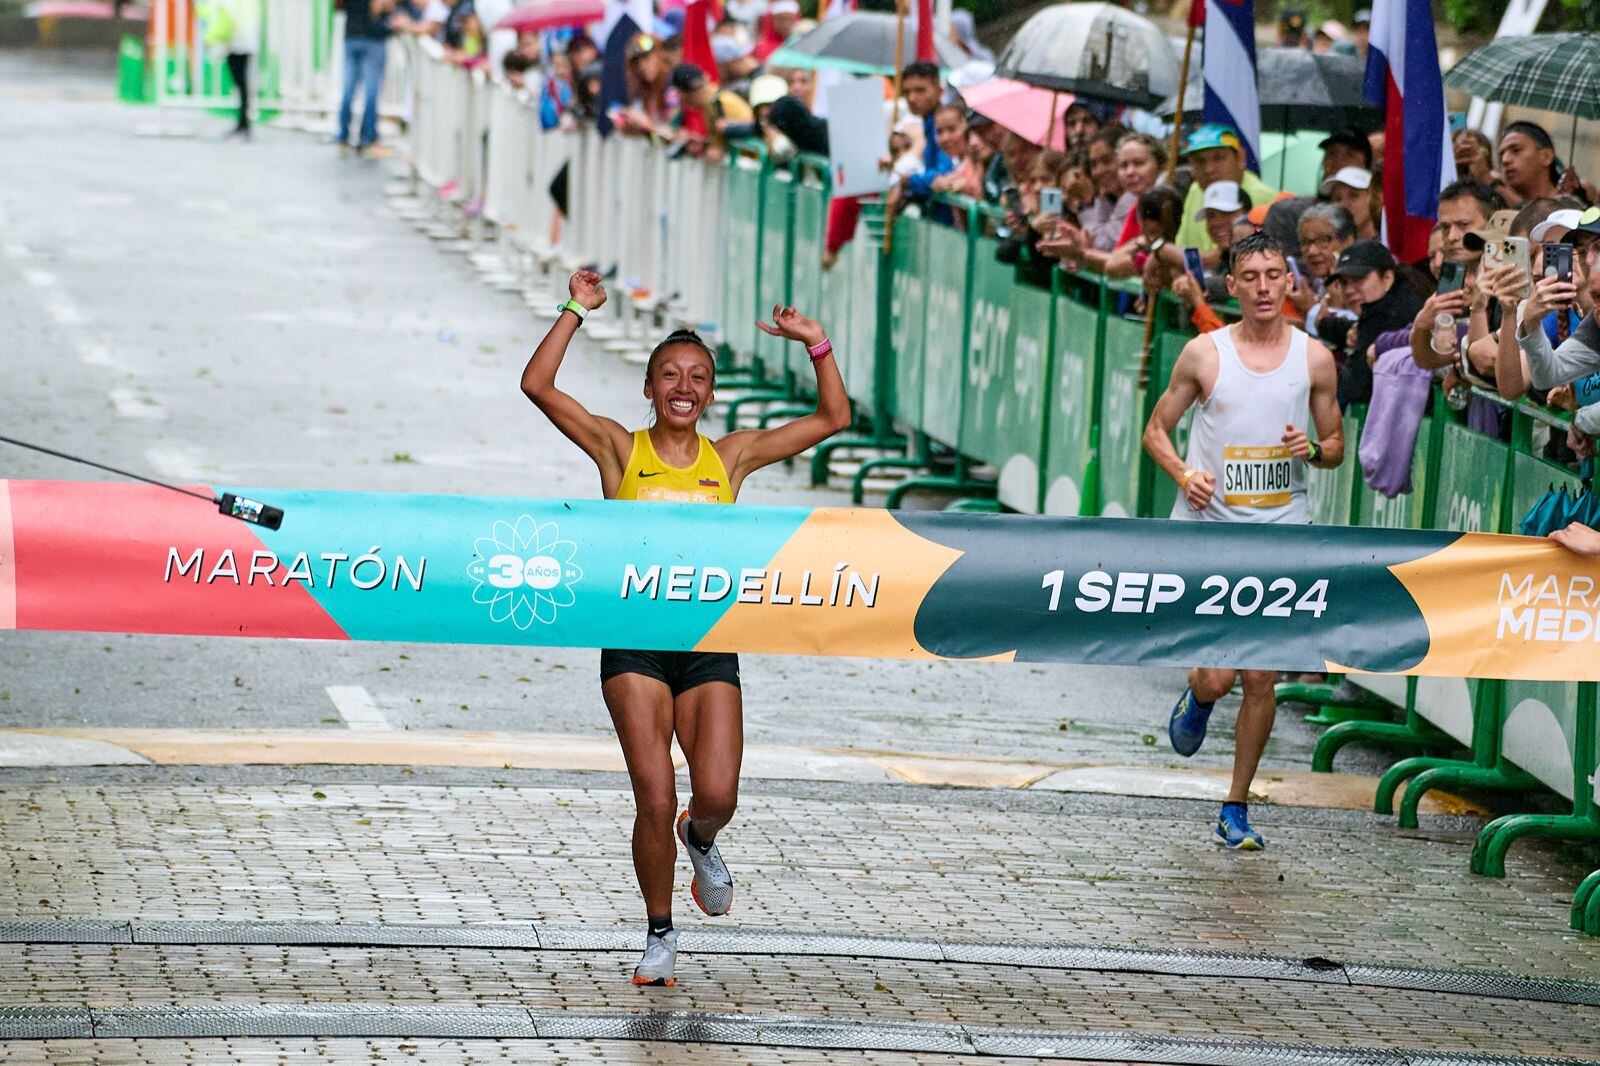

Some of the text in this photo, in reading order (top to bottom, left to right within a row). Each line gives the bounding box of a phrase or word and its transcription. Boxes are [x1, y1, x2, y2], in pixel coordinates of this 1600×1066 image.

[1226, 461, 1290, 491] SANTIAGO
[164, 545, 427, 592] MARATÓN
[488, 554, 561, 590] 30
[526, 565, 559, 577] AÑOS
[620, 562, 880, 608] MEDELLÍN
[1041, 570, 1329, 618] 1 SEP 2024
